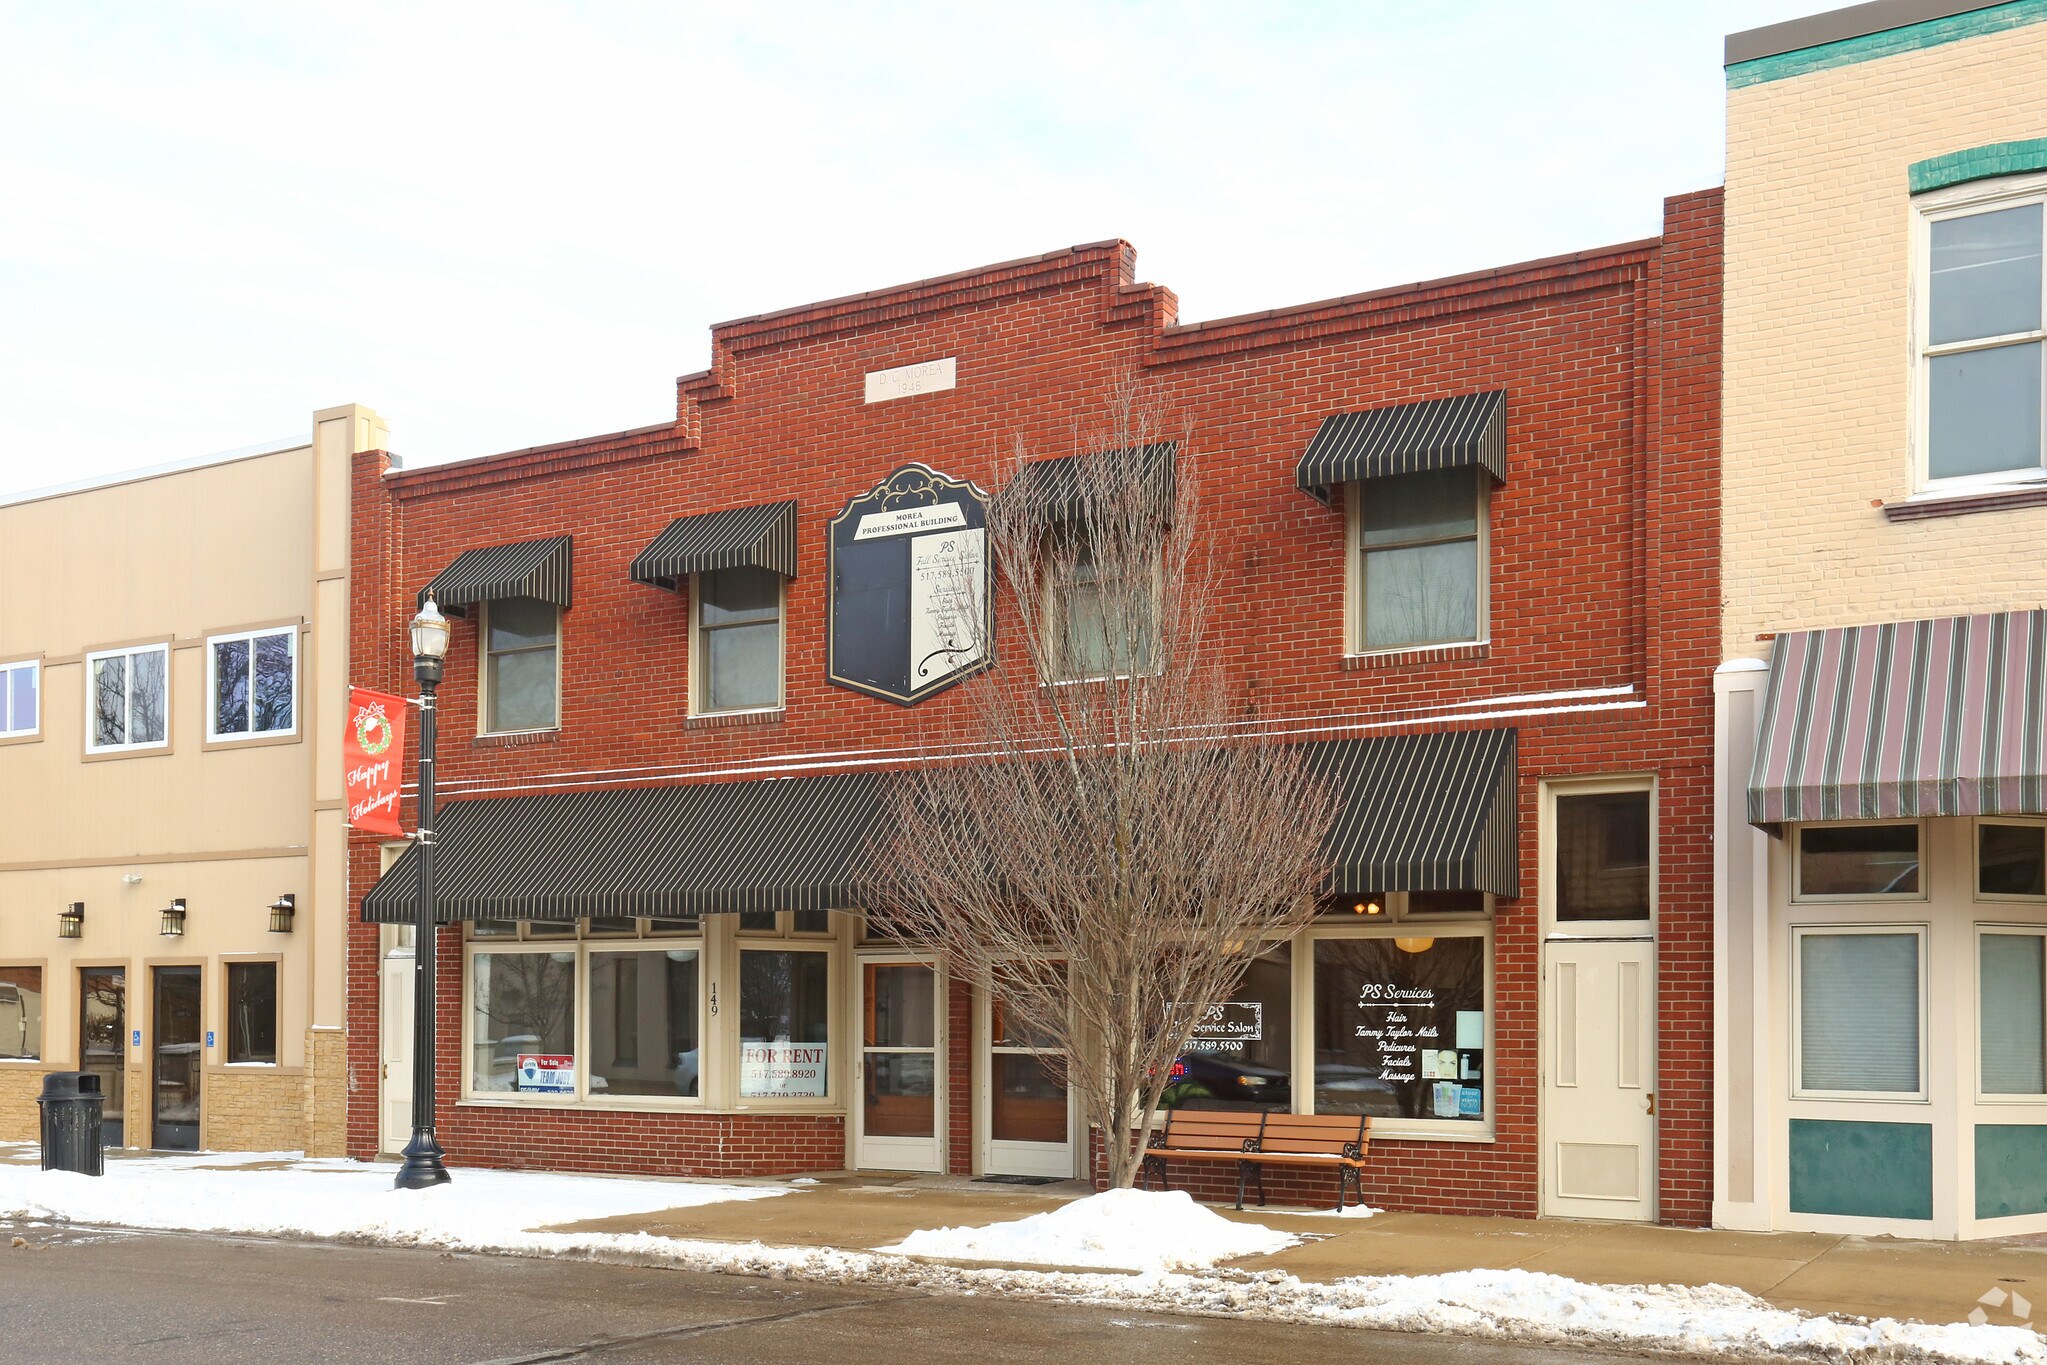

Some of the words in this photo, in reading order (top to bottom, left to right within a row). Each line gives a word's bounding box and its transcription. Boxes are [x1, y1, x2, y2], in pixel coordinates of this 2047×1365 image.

[895, 512, 923, 521] MOREA
[862, 521, 919, 535] PROFESSIONAL
[920, 515, 958, 527] BUILDING
[940, 540, 955, 553] PS
[347, 760, 390, 790] Happy
[351, 789, 398, 820] Holidays
[1359, 983, 1382, 999] PS
[1384, 983, 1434, 999] Services
[710, 982, 718, 1017] 149
[1202, 1005, 1224, 1020] PS
[1386, 1011, 1407, 1023] Hair
[1227, 1021, 1254, 1033] Salon
[1355, 1025, 1383, 1039] Tammy
[1385, 1025, 1413, 1039] Taylor
[1415, 1026, 1439, 1038] Nails
[1182, 1041, 1244, 1051] 517.589.5500
[1376, 1041, 1416, 1052] Pedicures
[746, 1048, 778, 1064] FOR
[783, 1048, 823, 1064] RENT
[1381, 1055, 1412, 1067] Facials
[540, 1071, 555, 1084] TEAM
[1378, 1069, 1415, 1083] Massage
